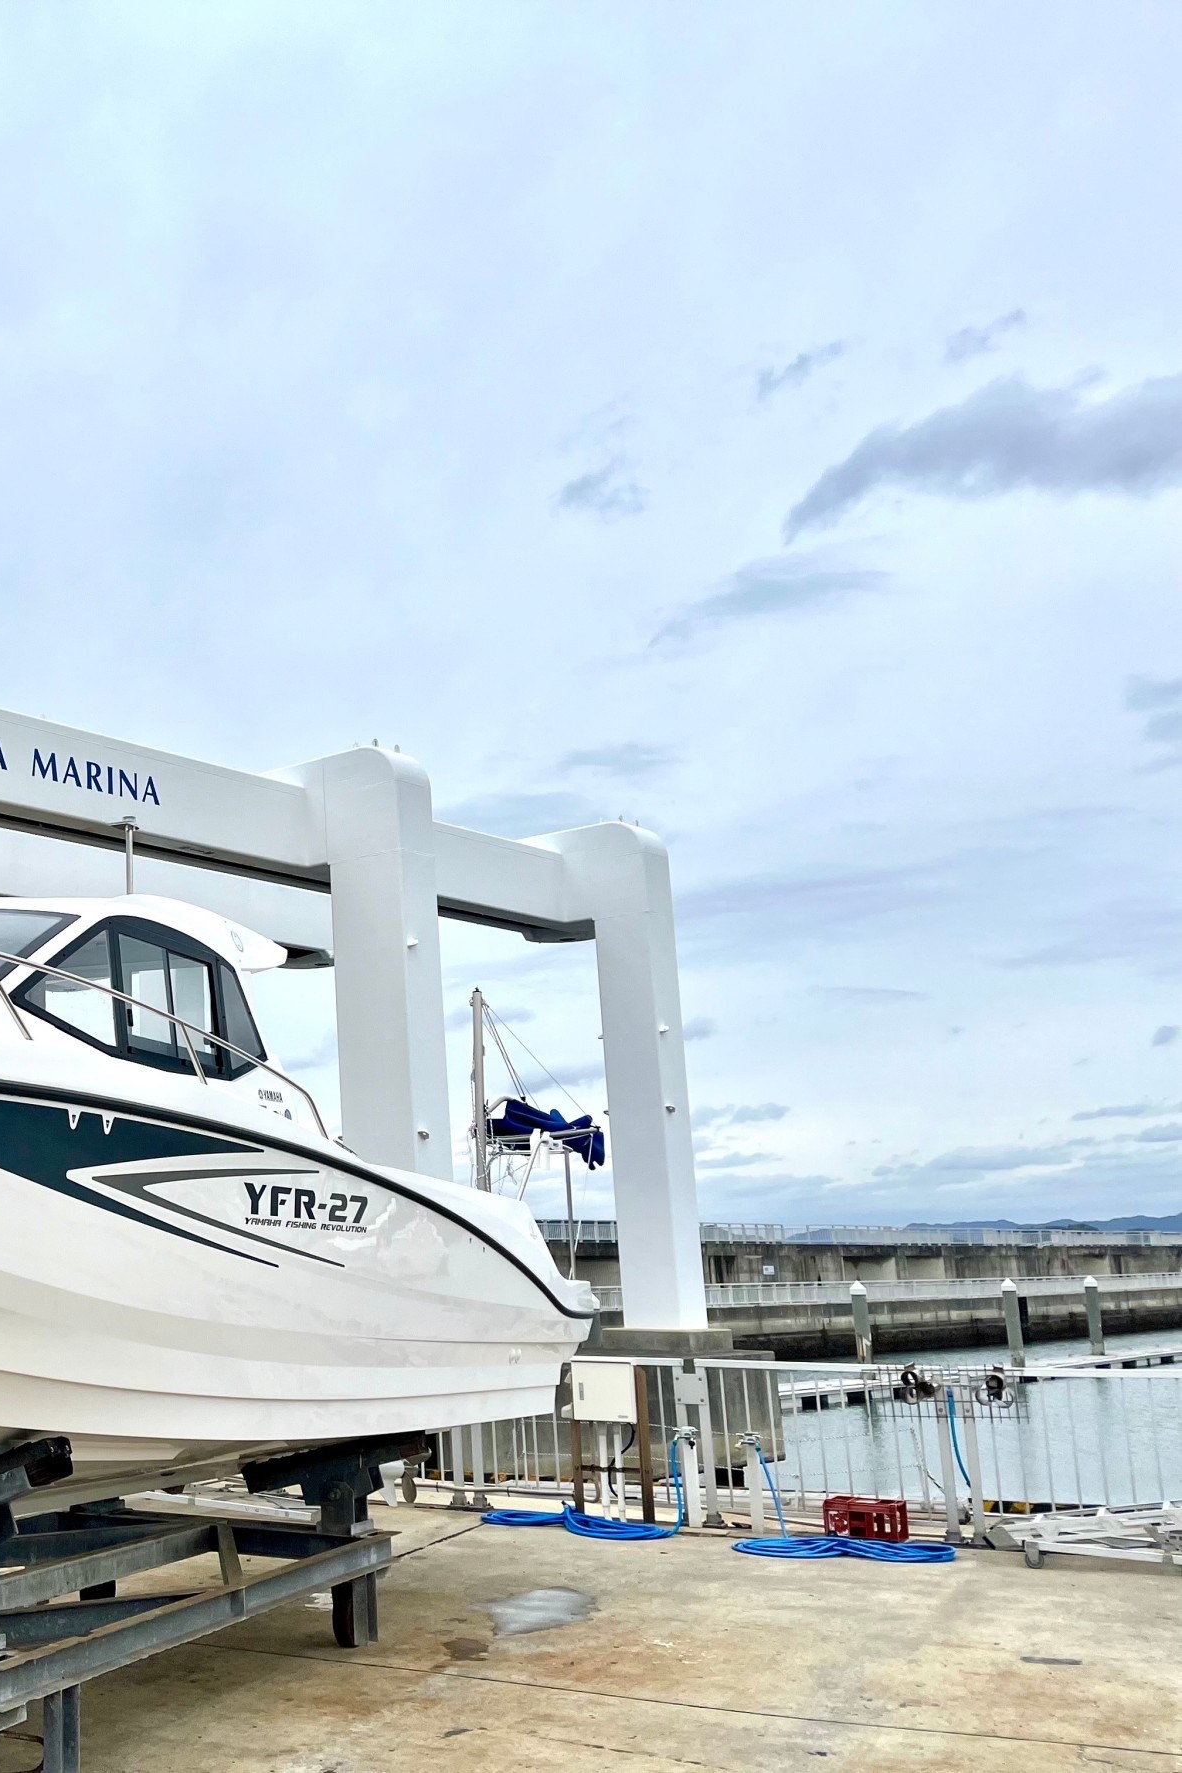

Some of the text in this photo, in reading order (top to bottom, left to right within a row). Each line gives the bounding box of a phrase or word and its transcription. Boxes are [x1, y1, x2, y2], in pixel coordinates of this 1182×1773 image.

[31, 747, 161, 806] MARINA
[263, 1089, 284, 1102] YAMAHA
[243, 1181, 368, 1224] YFR-27
[244, 1217, 368, 1234] YAMAHA FISHING REVOLUTION
